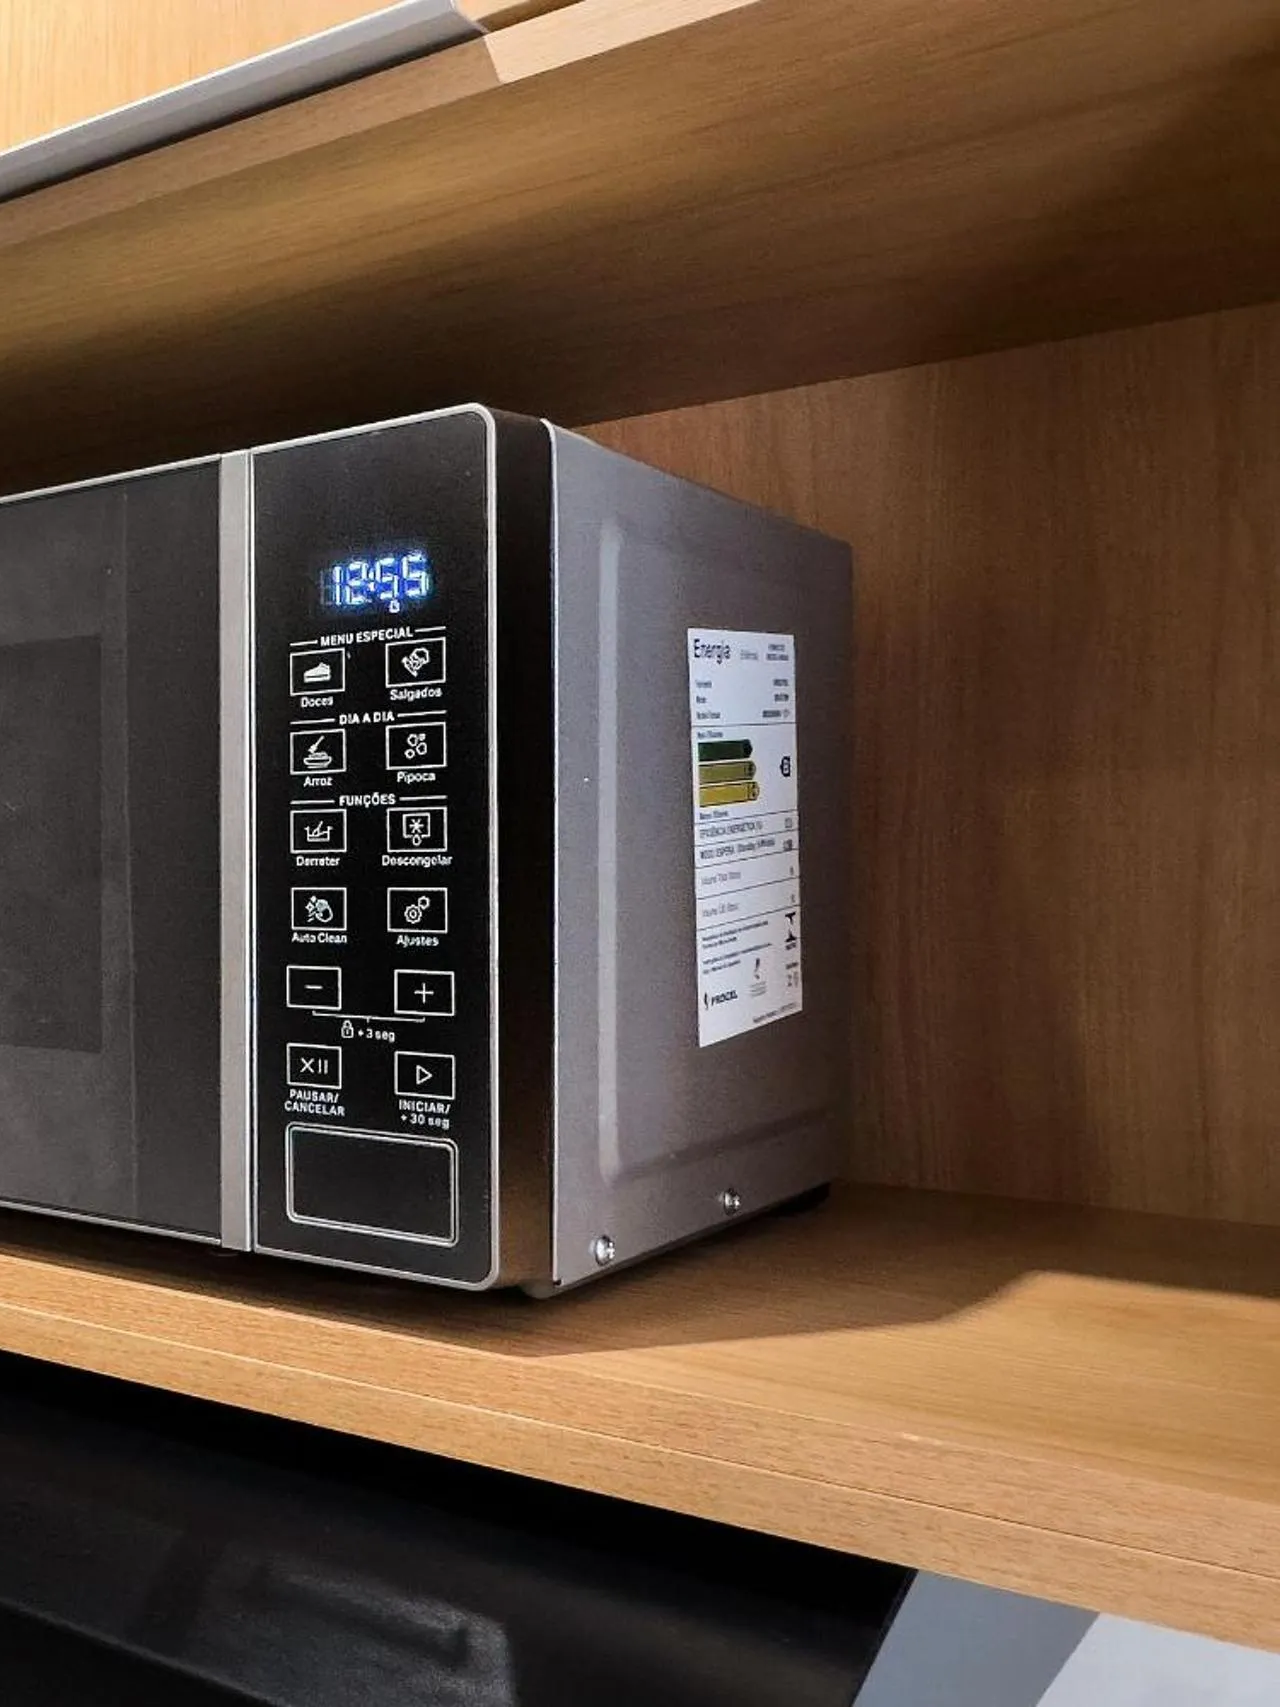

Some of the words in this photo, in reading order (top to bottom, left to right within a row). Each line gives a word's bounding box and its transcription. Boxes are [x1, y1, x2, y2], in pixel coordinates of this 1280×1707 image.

[332, 552, 430, 606] 12:55
[320, 633, 353, 648] MENU
[356, 627, 414, 643] ESPECIAL
[389, 686, 443, 702] Salgados
[300, 696, 334, 708] Doces
[338, 712, 361, 725] DIA
[362, 712, 372, 724] A
[372, 710, 395, 723] DIA
[303, 775, 333, 787] Arroz
[396, 770, 437, 784] Pipoca
[338, 792, 396, 808] FUNÇÕES
[295, 855, 341, 867] Derreter
[381, 854, 453, 868] Descongelar
[291, 932, 316, 944] Auto
[317, 932, 348, 944] Clean
[395, 934, 440, 948] Ajustes
[366, 1028, 374, 1039] 3
[374, 1029, 396, 1043] seg
[289, 1088, 339, 1104] PAUSAR/
[284, 1100, 346, 1117] CANCELAR
[398, 1098, 452, 1115] INICIAR/
[409, 1113, 426, 1125] 30
[427, 1116, 450, 1130] seg
